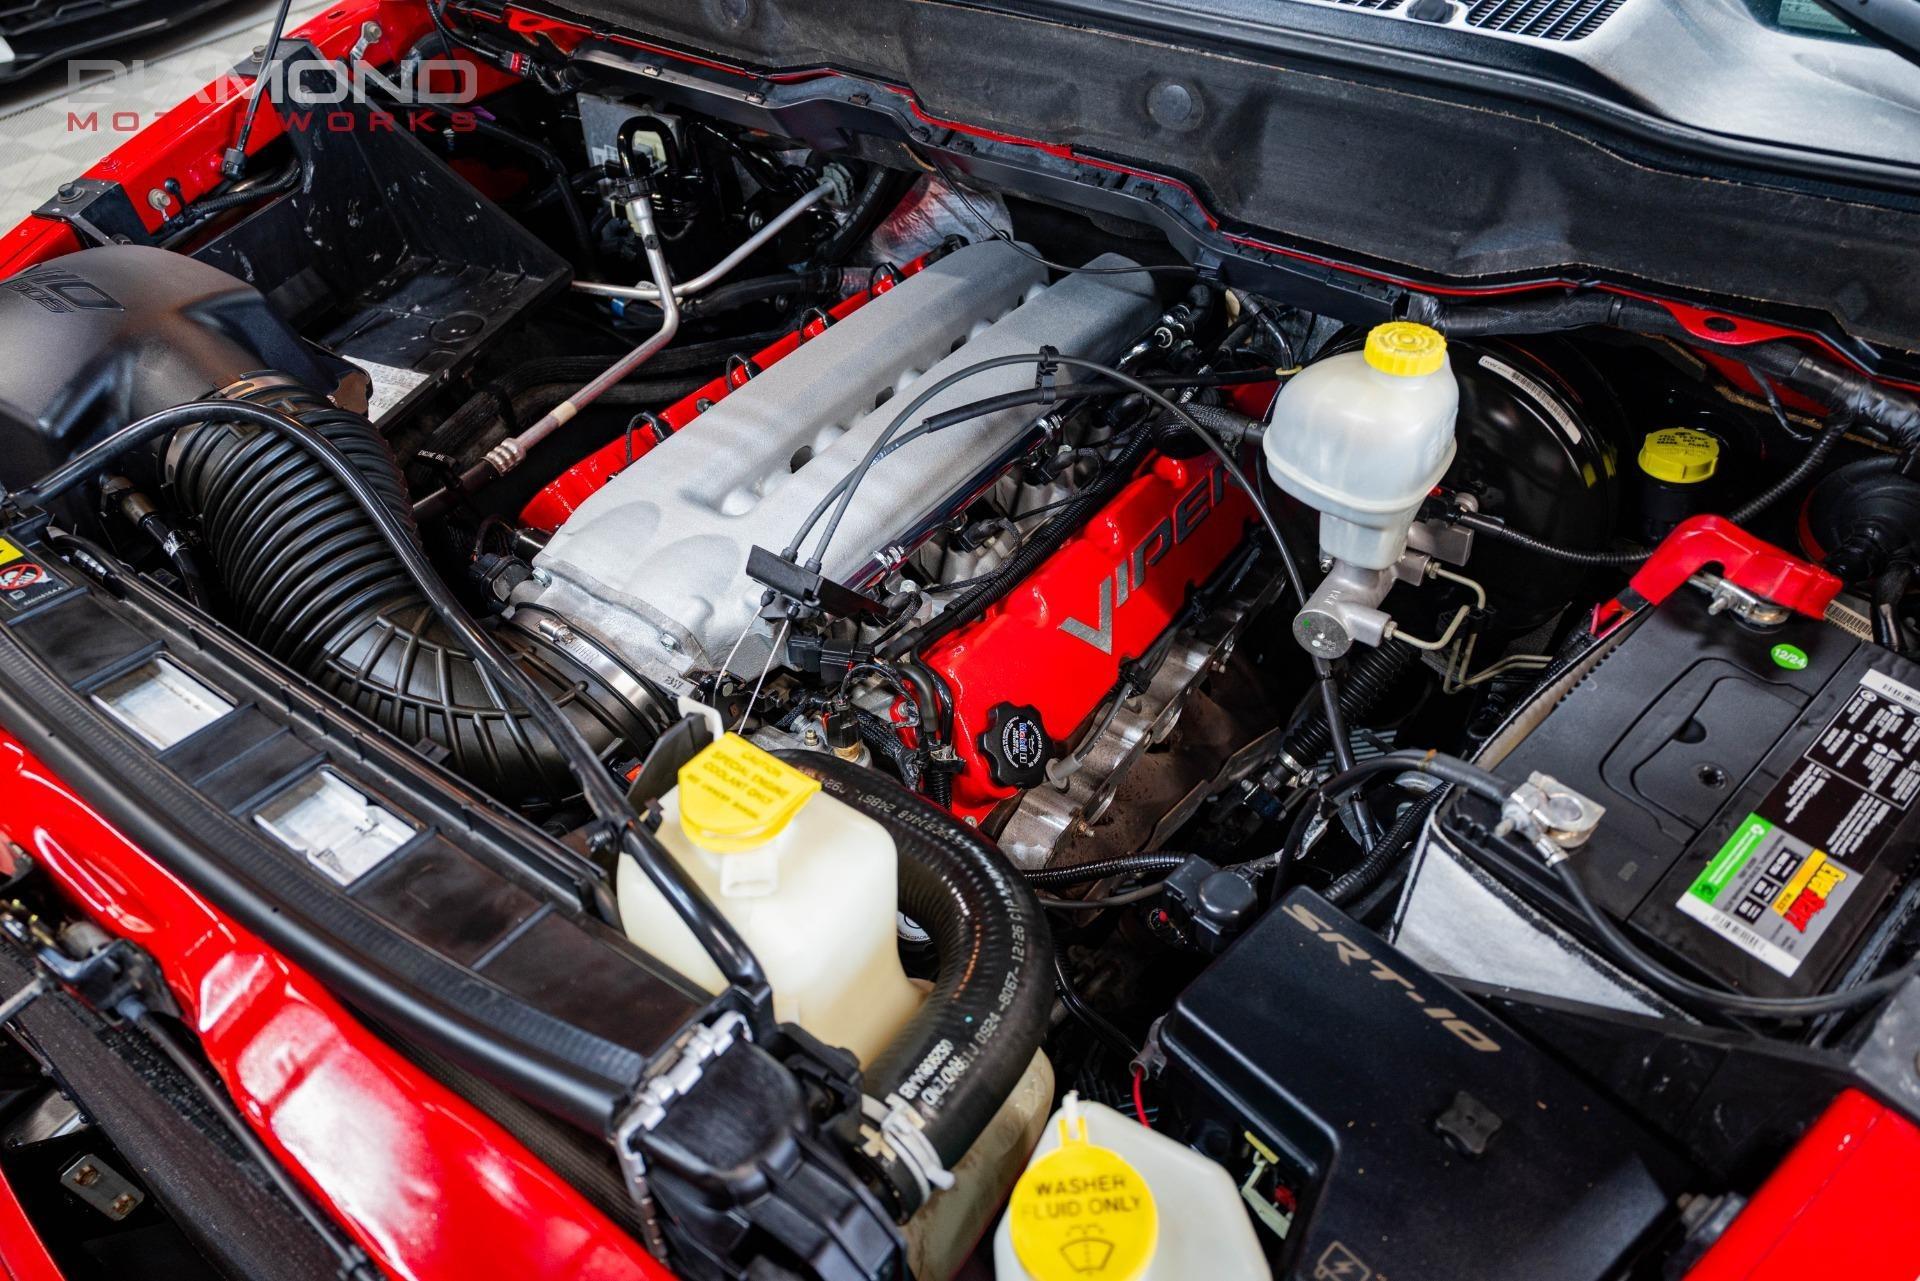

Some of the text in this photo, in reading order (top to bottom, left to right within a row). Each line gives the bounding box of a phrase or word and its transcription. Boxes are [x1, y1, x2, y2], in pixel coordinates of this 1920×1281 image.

[1774, 647, 1806, 668] 12/24
[1019, 722, 1028, 752] Mobil
[1281, 903, 1502, 1052] SRT-10
[1034, 1174, 1127, 1197] WASHER
[1087, 1196, 1142, 1216] ONLY
